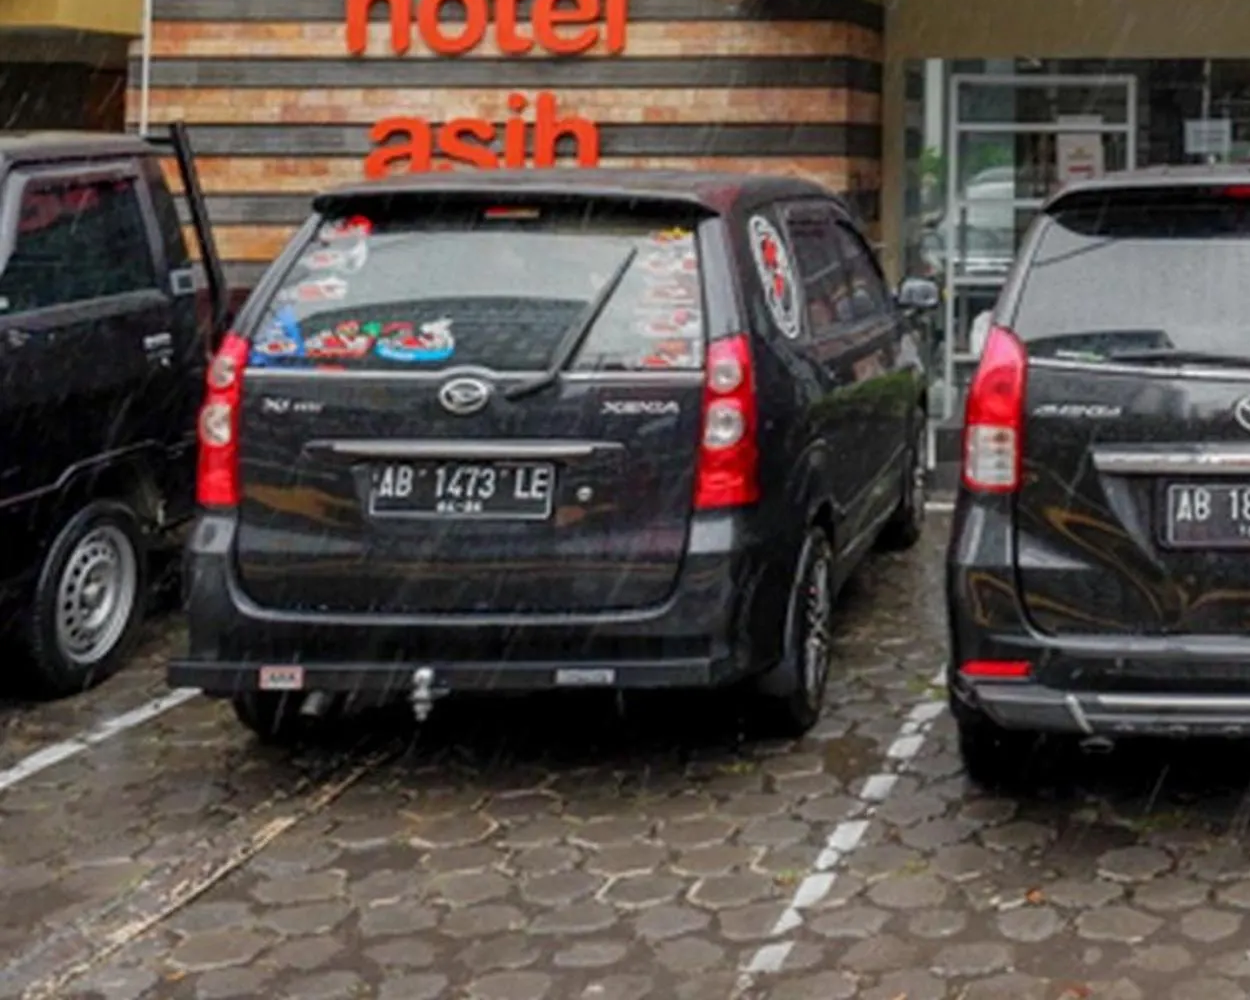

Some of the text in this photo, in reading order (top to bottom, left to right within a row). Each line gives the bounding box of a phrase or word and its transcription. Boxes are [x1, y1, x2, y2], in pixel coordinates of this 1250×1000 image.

[363, 90, 600, 180] asih
[378, 465, 549, 499] AB 1473 LE
[1176, 486, 1212, 521] AB
